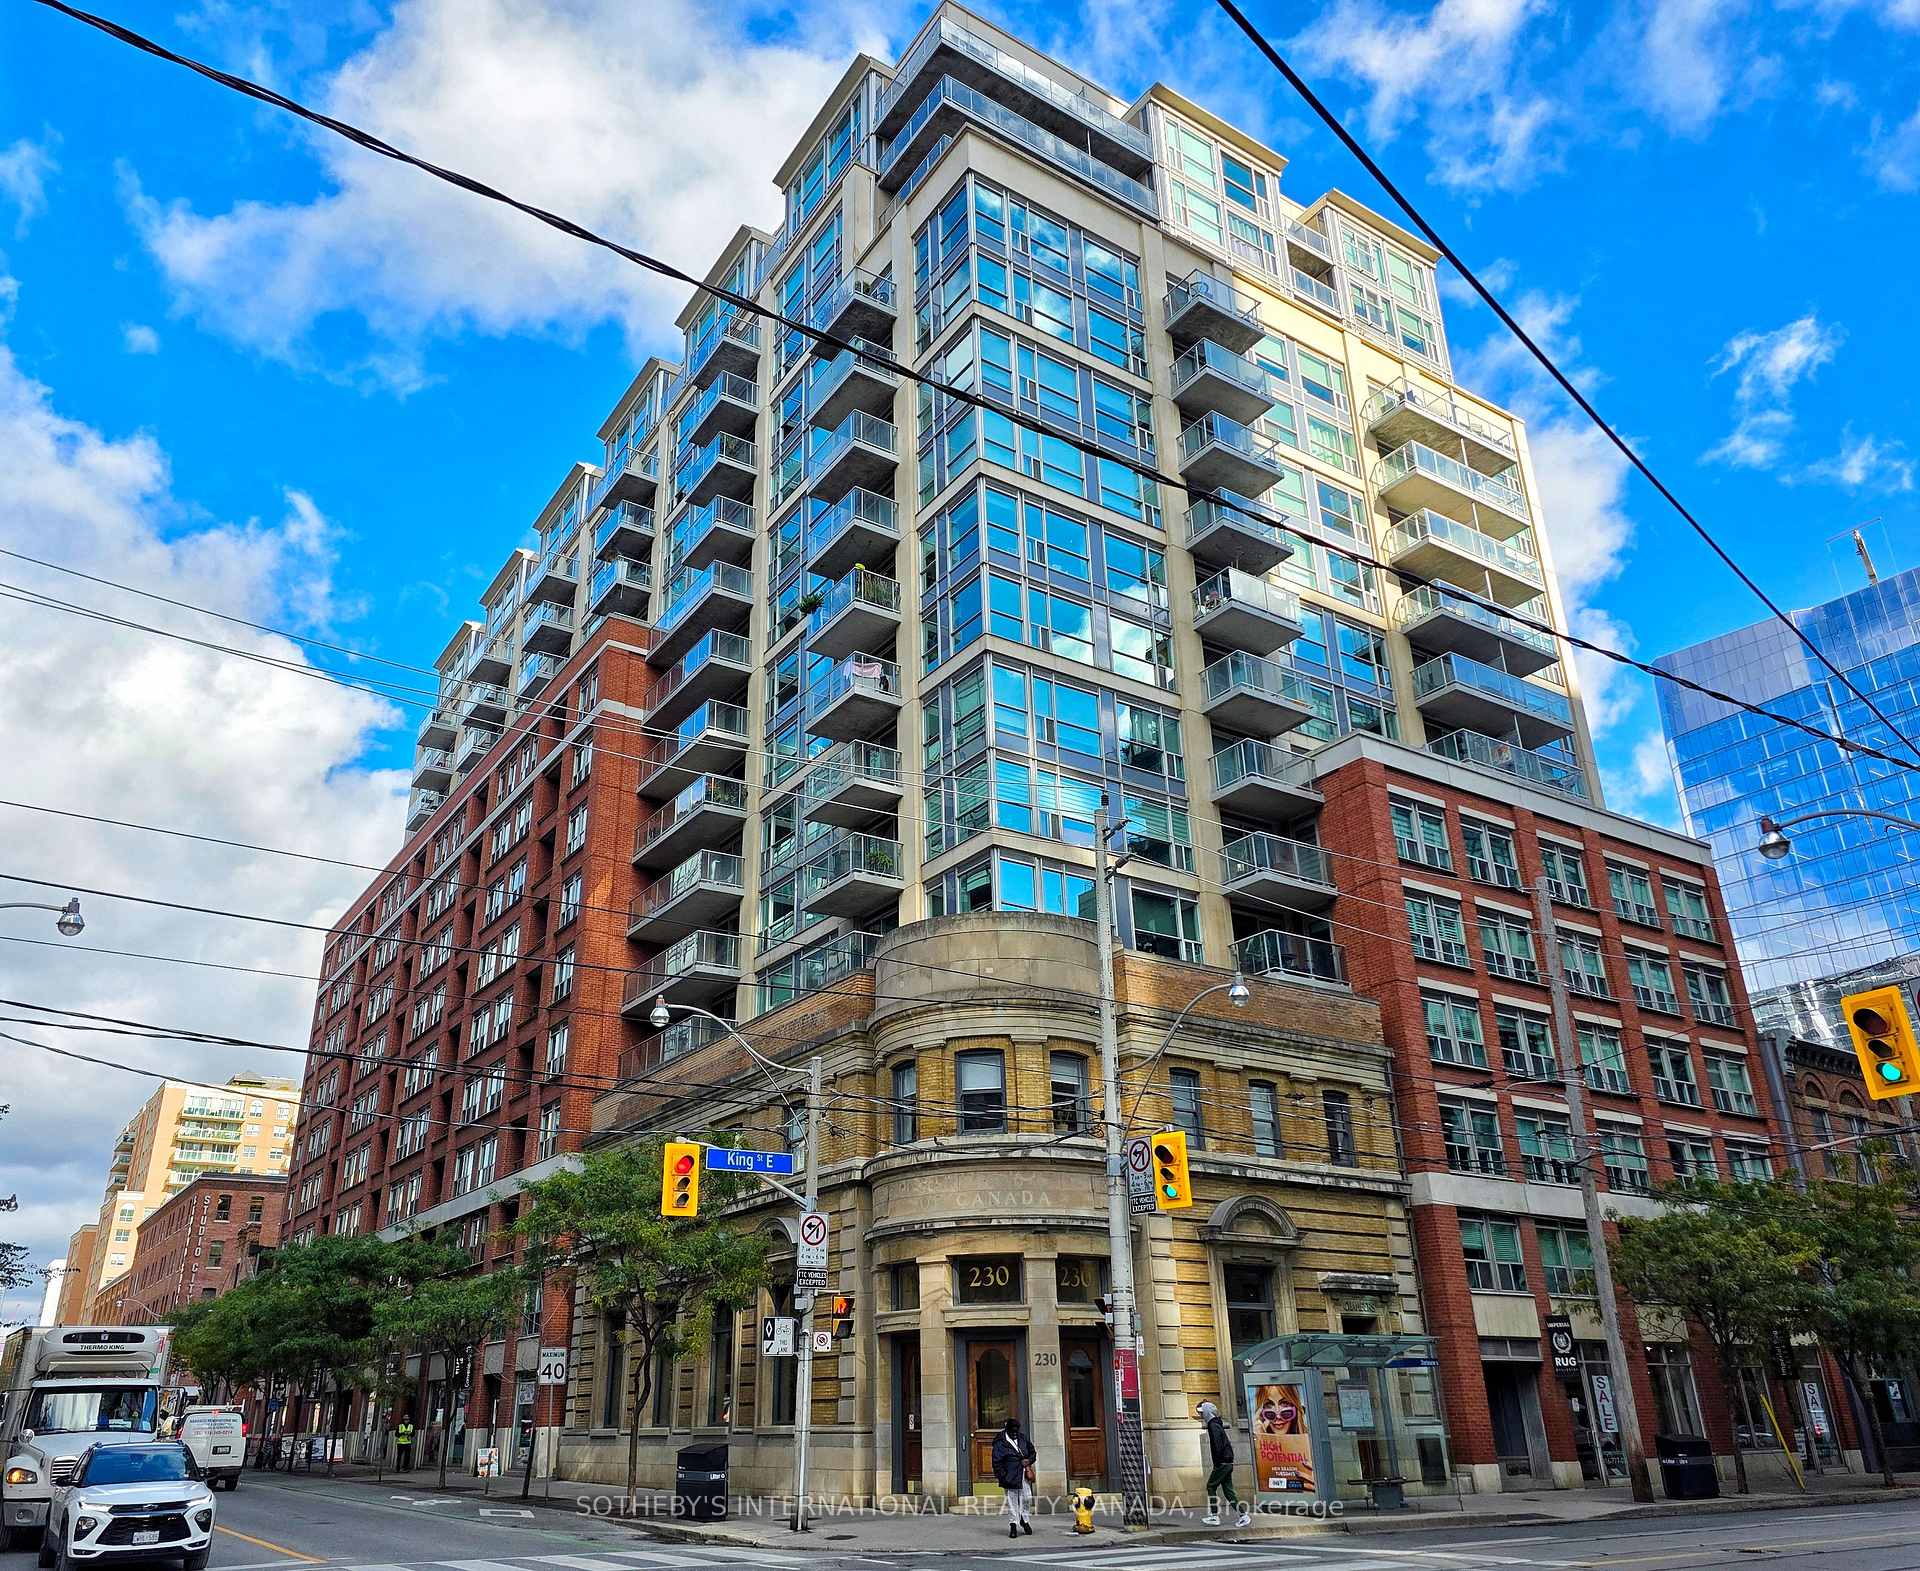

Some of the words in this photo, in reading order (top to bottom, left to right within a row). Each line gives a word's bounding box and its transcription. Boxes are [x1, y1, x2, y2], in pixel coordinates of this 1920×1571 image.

[727, 1152, 754, 1170] King
[766, 1155, 774, 1168] E
[956, 1191, 1050, 1206] CANADA
[1133, 1204, 1154, 1212] EXCEPTED
[194, 1196, 211, 1256] STUDIO
[187, 1263, 198, 1304] CITY
[969, 1266, 1009, 1287] 230
[1060, 1266, 1092, 1287] 230
[1034, 1353, 1057, 1366] 230
[1555, 1357, 1577, 1366] RUG
[541, 1363, 564, 1380] 40
[1596, 1377, 1615, 1430] SALE
[1260, 1440, 1282, 1452] HIGH
[1261, 1451, 1308, 1463] POTENTIAL
